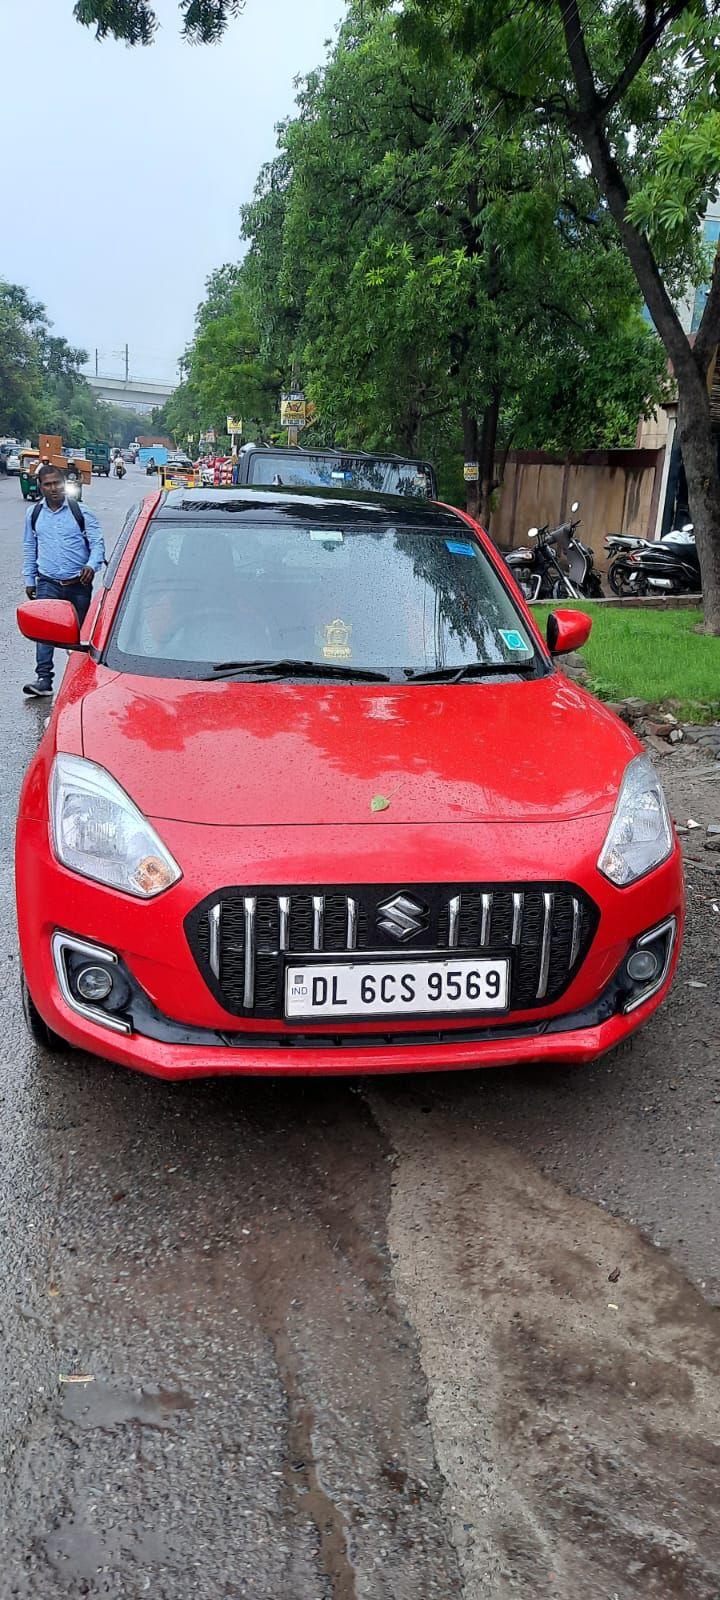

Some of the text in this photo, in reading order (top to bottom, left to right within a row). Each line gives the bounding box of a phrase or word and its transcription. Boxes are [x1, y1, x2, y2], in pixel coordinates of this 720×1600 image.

[291, 986, 308, 996] IND
[312, 970, 501, 1006] DL 6CS 9569
